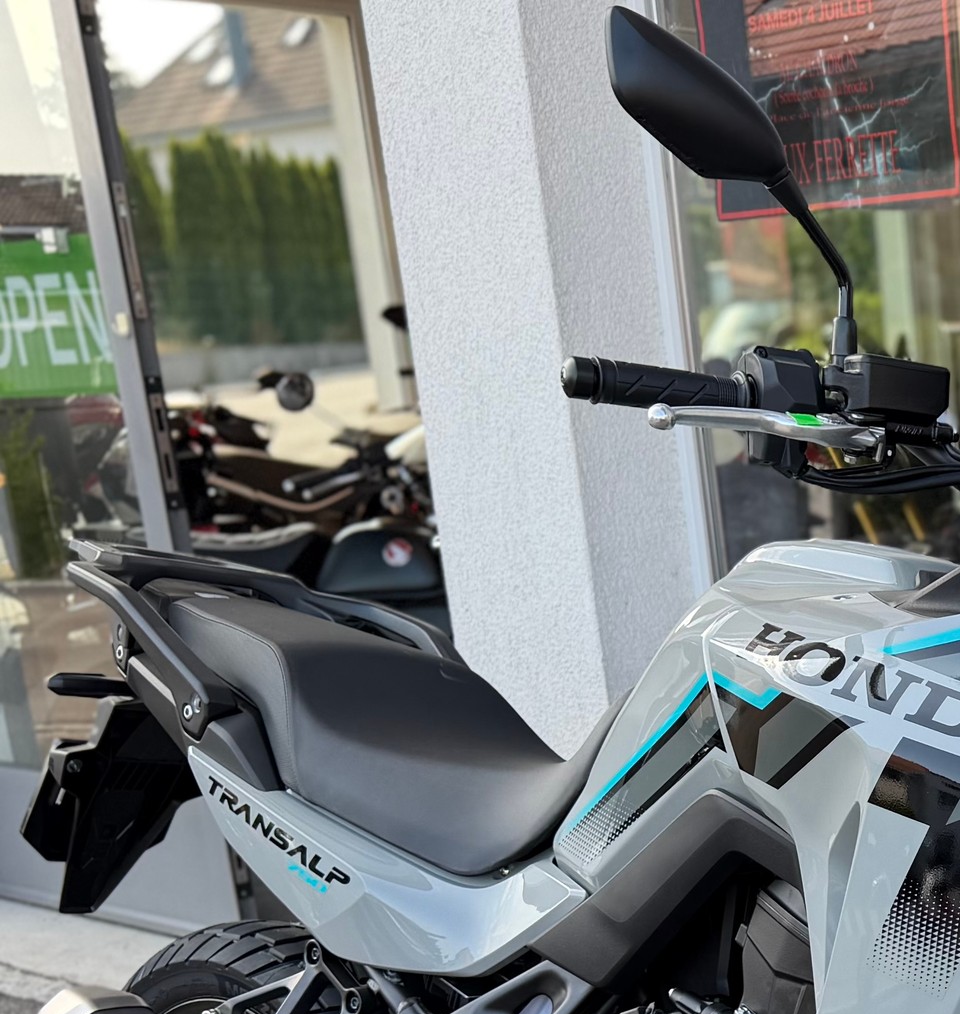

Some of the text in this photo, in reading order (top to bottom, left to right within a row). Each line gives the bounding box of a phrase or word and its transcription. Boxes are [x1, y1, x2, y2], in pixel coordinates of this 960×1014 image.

[747, 0, 874, 33] SAMEDI 4 JUILLET
[784, 129, 902, 185] UX-FERRETTE
[208, 775, 351, 885] TRANSALP
